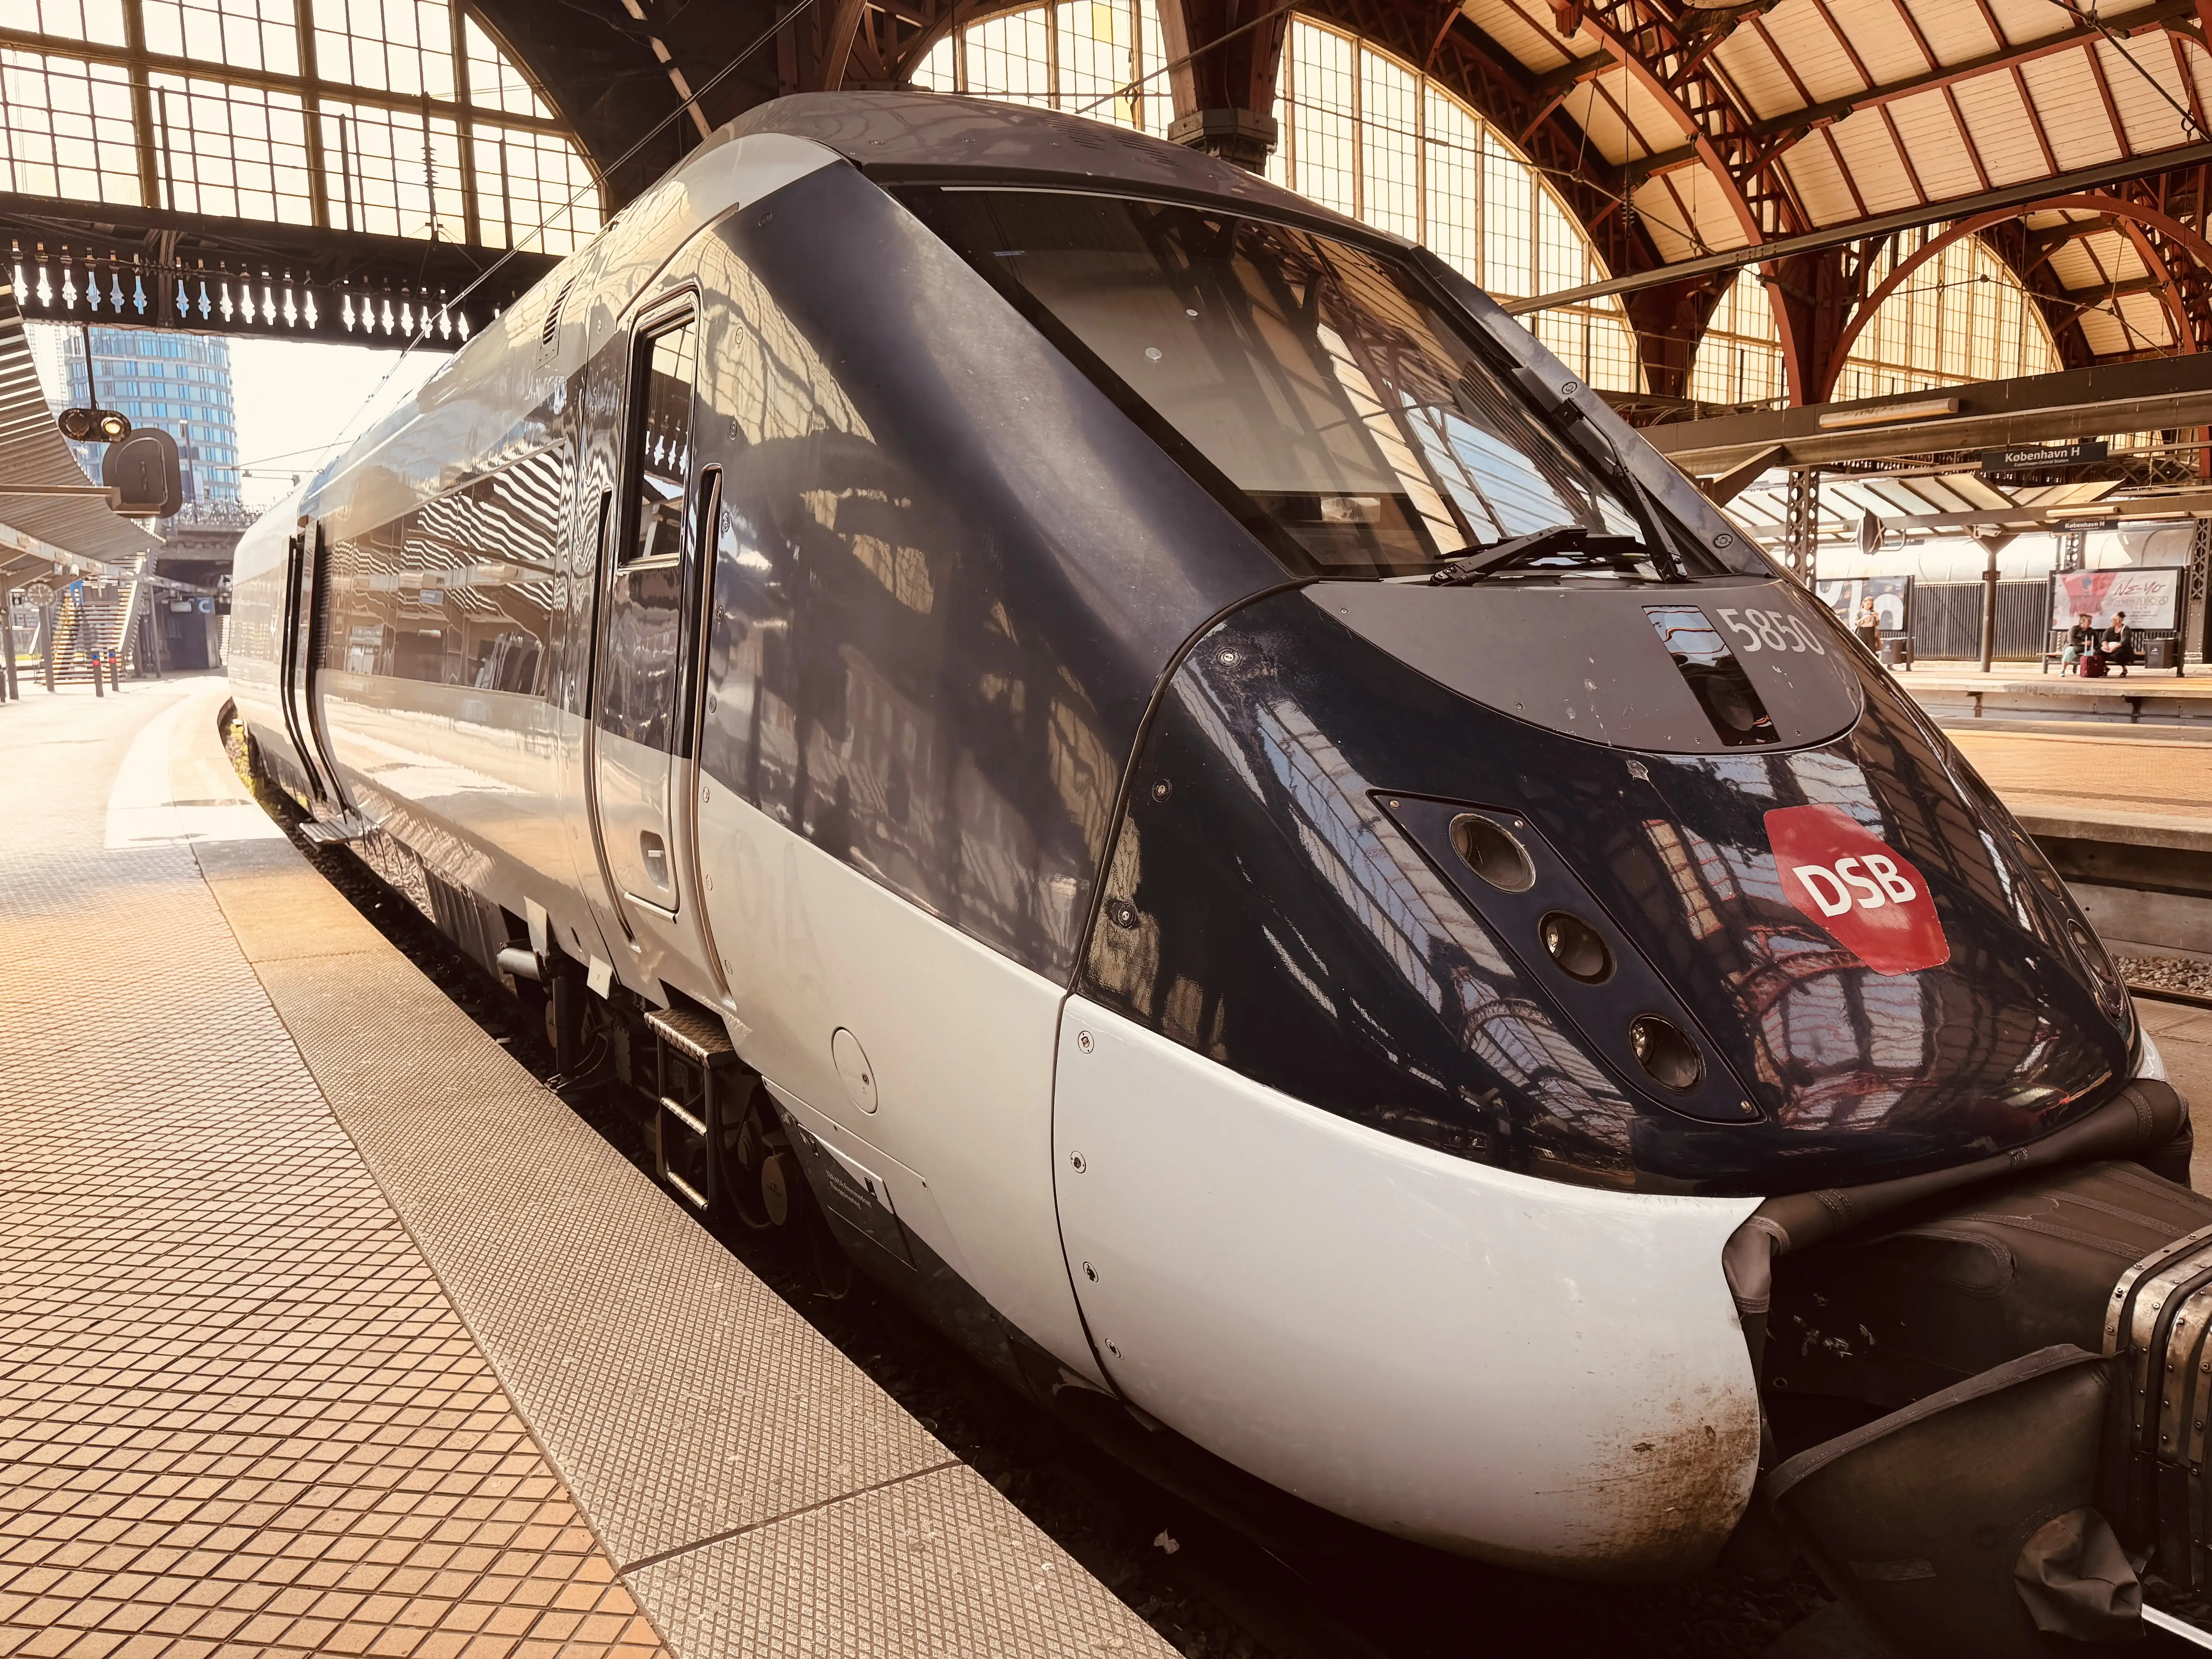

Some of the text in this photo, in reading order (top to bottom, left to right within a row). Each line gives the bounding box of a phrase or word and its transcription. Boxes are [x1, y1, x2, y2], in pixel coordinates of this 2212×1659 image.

[2005, 447, 2080, 462] København H
[1716, 609, 1825, 655] 5850
[1792, 854, 1916, 917] DSB
